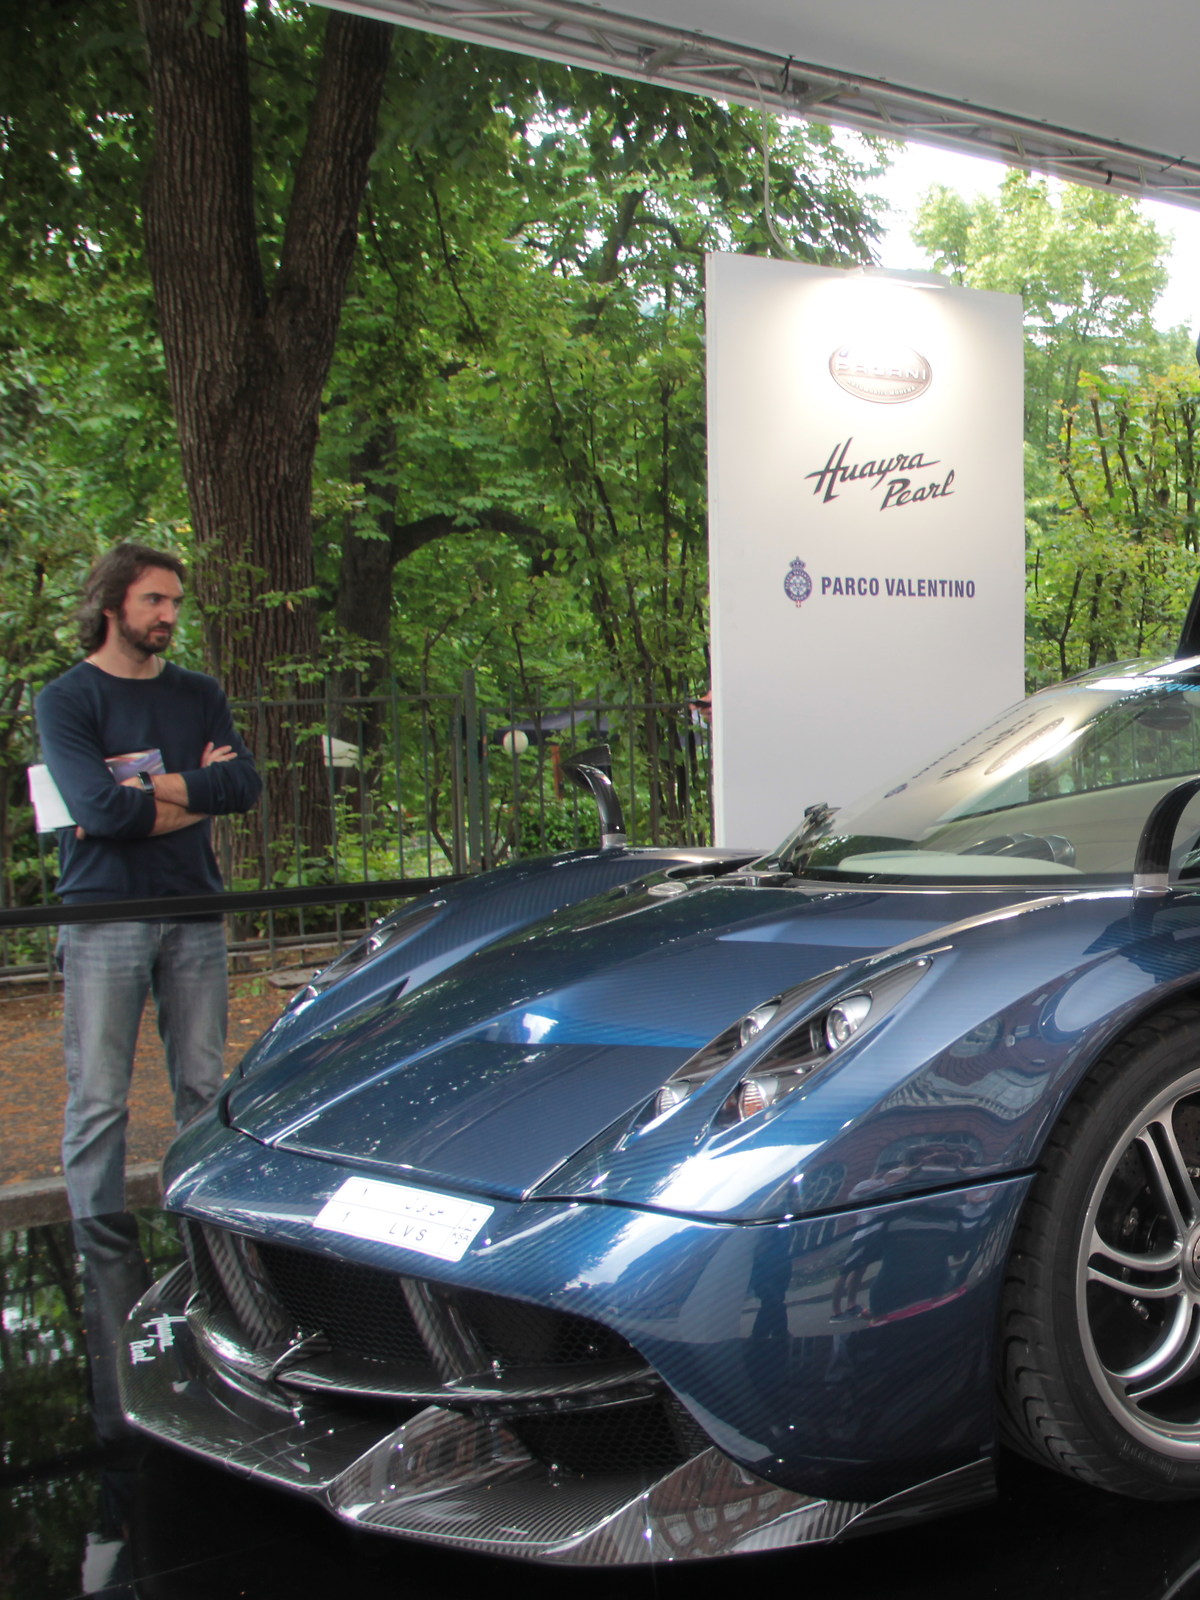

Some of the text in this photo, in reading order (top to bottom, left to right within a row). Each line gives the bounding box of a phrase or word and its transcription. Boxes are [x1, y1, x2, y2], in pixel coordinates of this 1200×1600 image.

[804, 436, 941, 504] Huayra
[880, 469, 956, 512] Pearl
[821, 576, 880, 597] PARCO
[885, 578, 976, 599] VALENTINO
[388, 1221, 428, 1242] LVS
